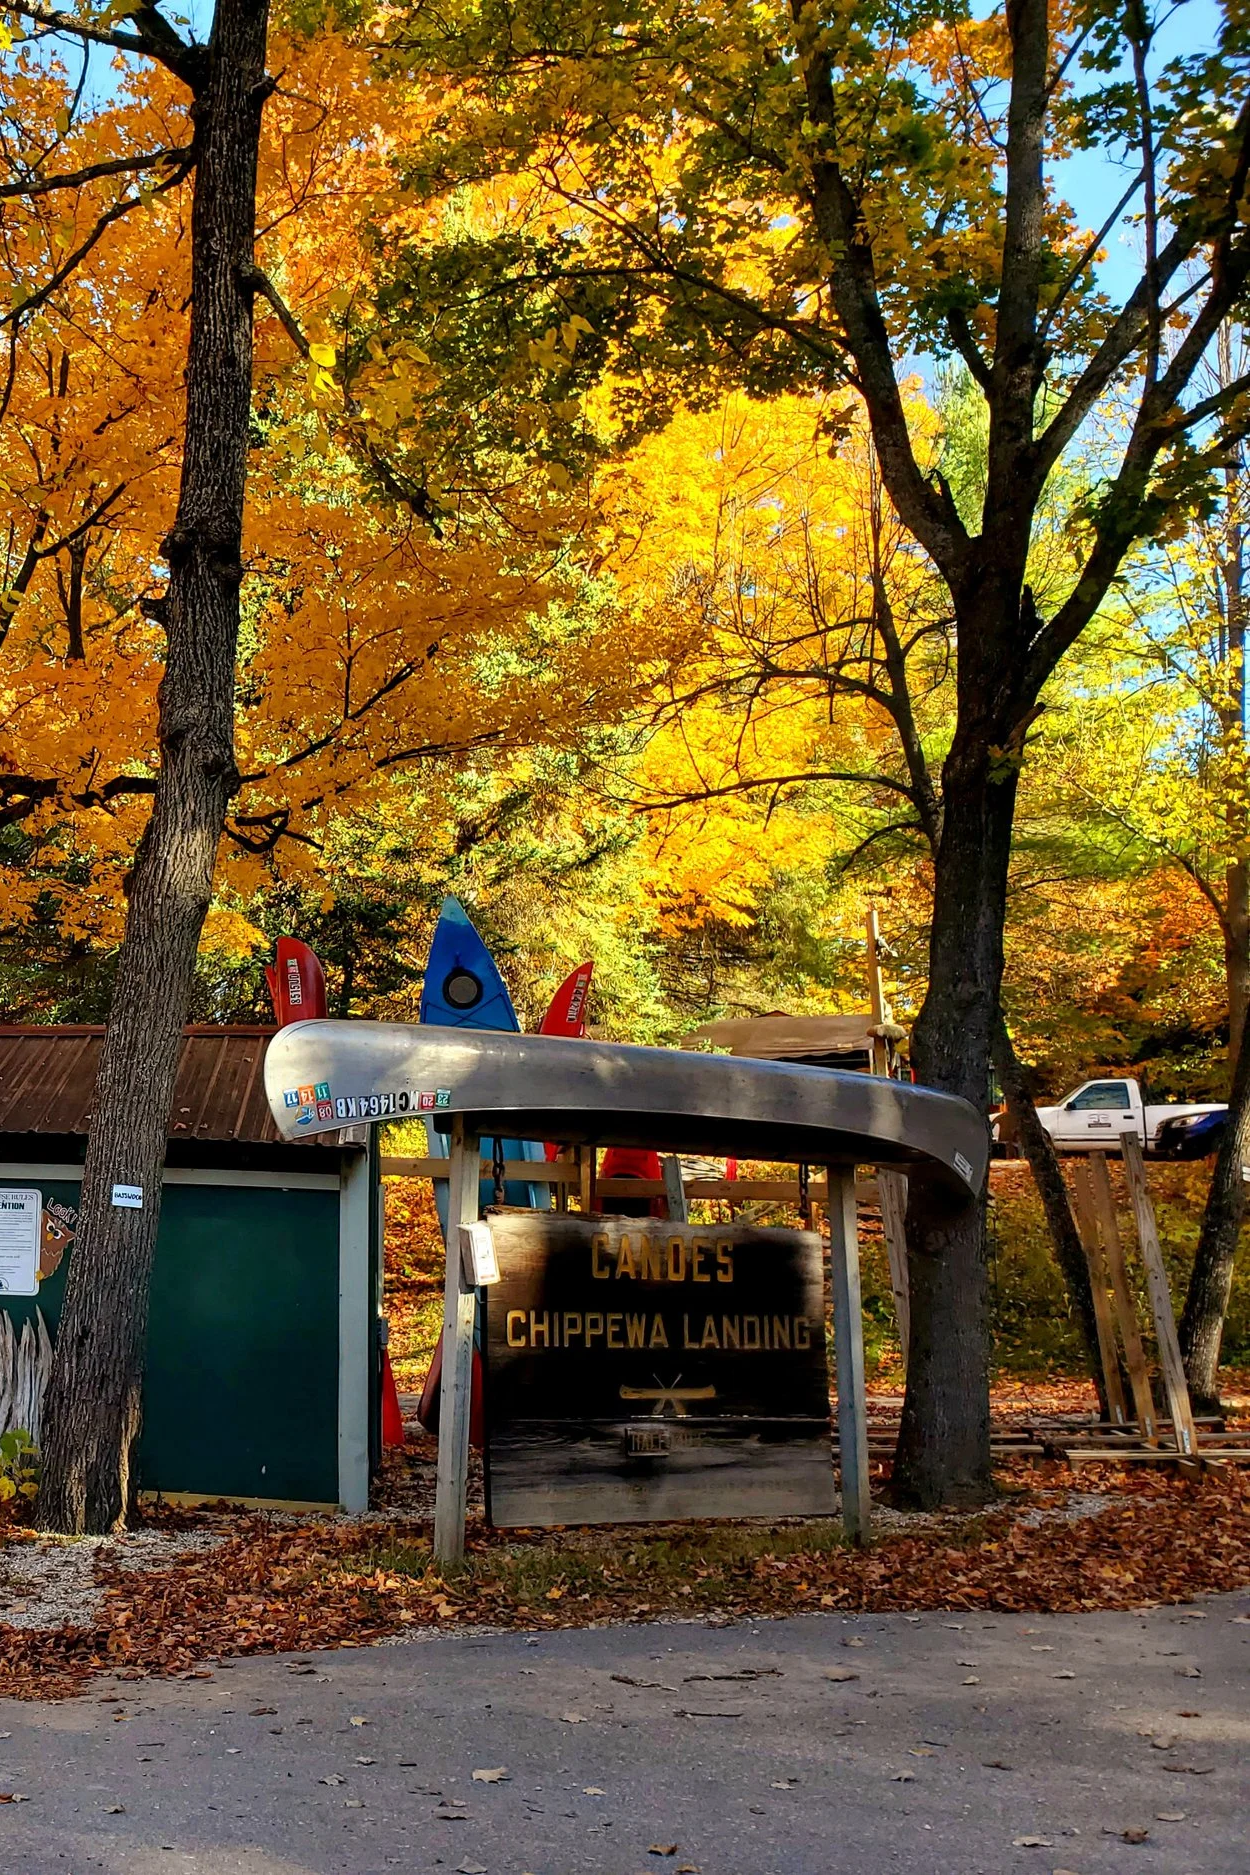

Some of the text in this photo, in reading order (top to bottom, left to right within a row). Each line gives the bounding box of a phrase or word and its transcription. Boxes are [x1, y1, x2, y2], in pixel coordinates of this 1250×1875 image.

[301, 1089, 314, 1101] 14
[317, 1085, 328, 1096] 11
[286, 1093, 298, 1104] 17
[422, 1096, 434, 1106] 20
[437, 1094, 449, 1104] 23
[336, 1091, 419, 1118] MC 1464 KB
[591, 1231, 735, 1283] CANOES
[506, 1309, 813, 1350] CHIPPEWA LANDING
